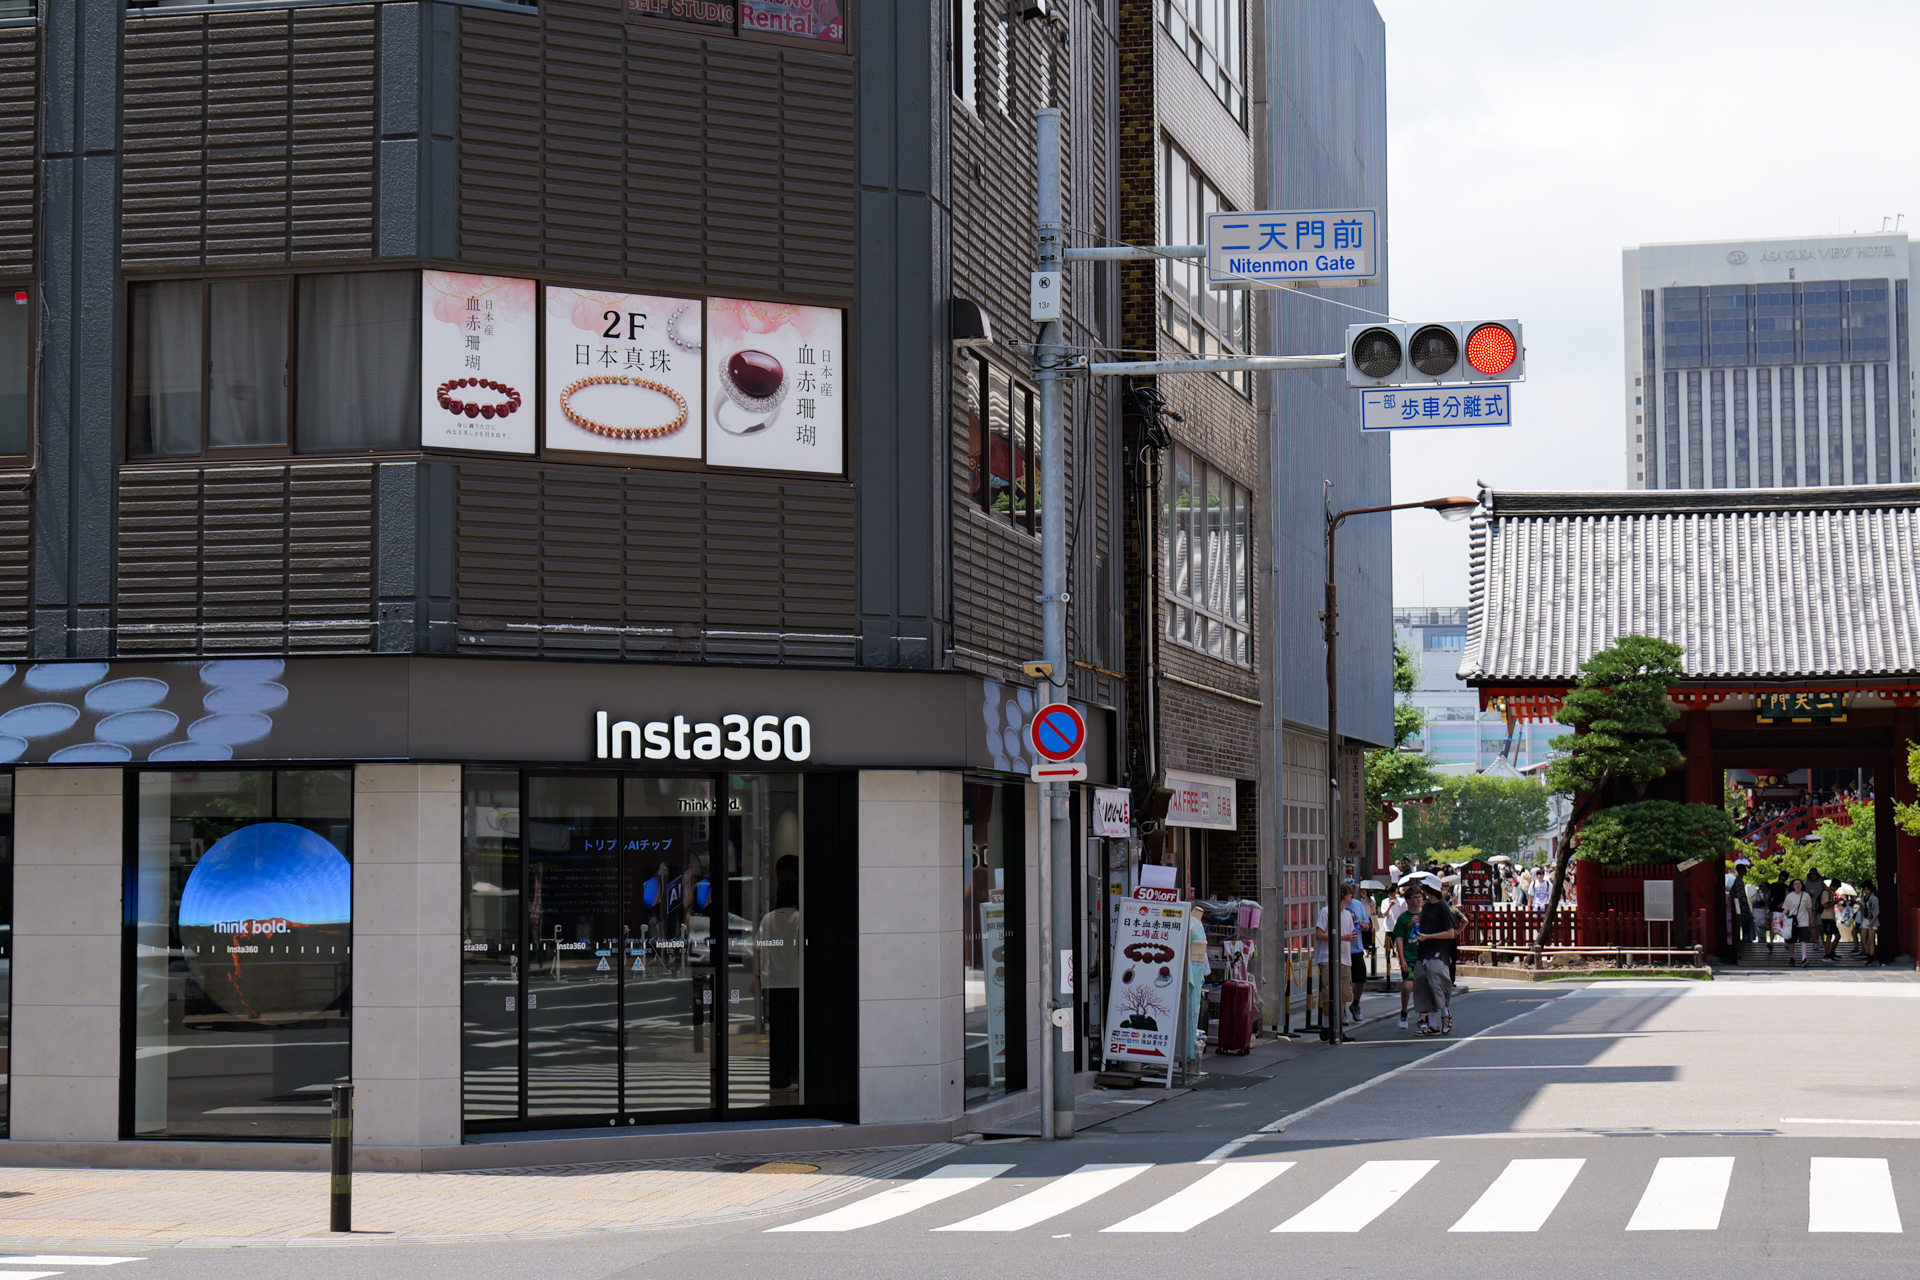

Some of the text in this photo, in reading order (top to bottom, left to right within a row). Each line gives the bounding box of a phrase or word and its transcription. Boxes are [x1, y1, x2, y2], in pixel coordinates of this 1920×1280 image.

[672, 0, 735, 23] STUDIO
[741, 3, 813, 35] Rental
[1221, 219, 1363, 251] 二天門前
[1230, 254, 1355, 274] Nitenmon Gate
[1760, 245, 1896, 262] ASAKUSA VIEW HOTEL
[483, 299, 494, 336] 日本産
[602, 310, 647, 341] 2F
[465, 295, 481, 371] 血赤珊瑚
[575, 343, 672, 374] 日本真珠
[820, 349, 833, 397] 日本産
[796, 343, 816, 447] 血赤珊瑚
[1368, 393, 1503, 420] 一部 歩車分離式
[597, 711, 811, 761] Insta360
[1345, 748, 1359, 756] 119
[677, 798, 711, 811] Think
[1183, 790, 1198, 813] FREE
[669, 883, 682, 905] AI
[1138, 889, 1177, 901] 50%OFF
[213, 920, 291, 934] Think bold.
[1124, 918, 1181, 931] 日本血赤珊瑚
[1131, 929, 1169, 940] 工場直送
[226, 945, 259, 954] Insta360
[556, 942, 586, 950] Insta360
[656, 941, 685, 949] Insta360
[756, 939, 784, 947] Insta360
[1110, 1043, 1127, 1054] 2F
